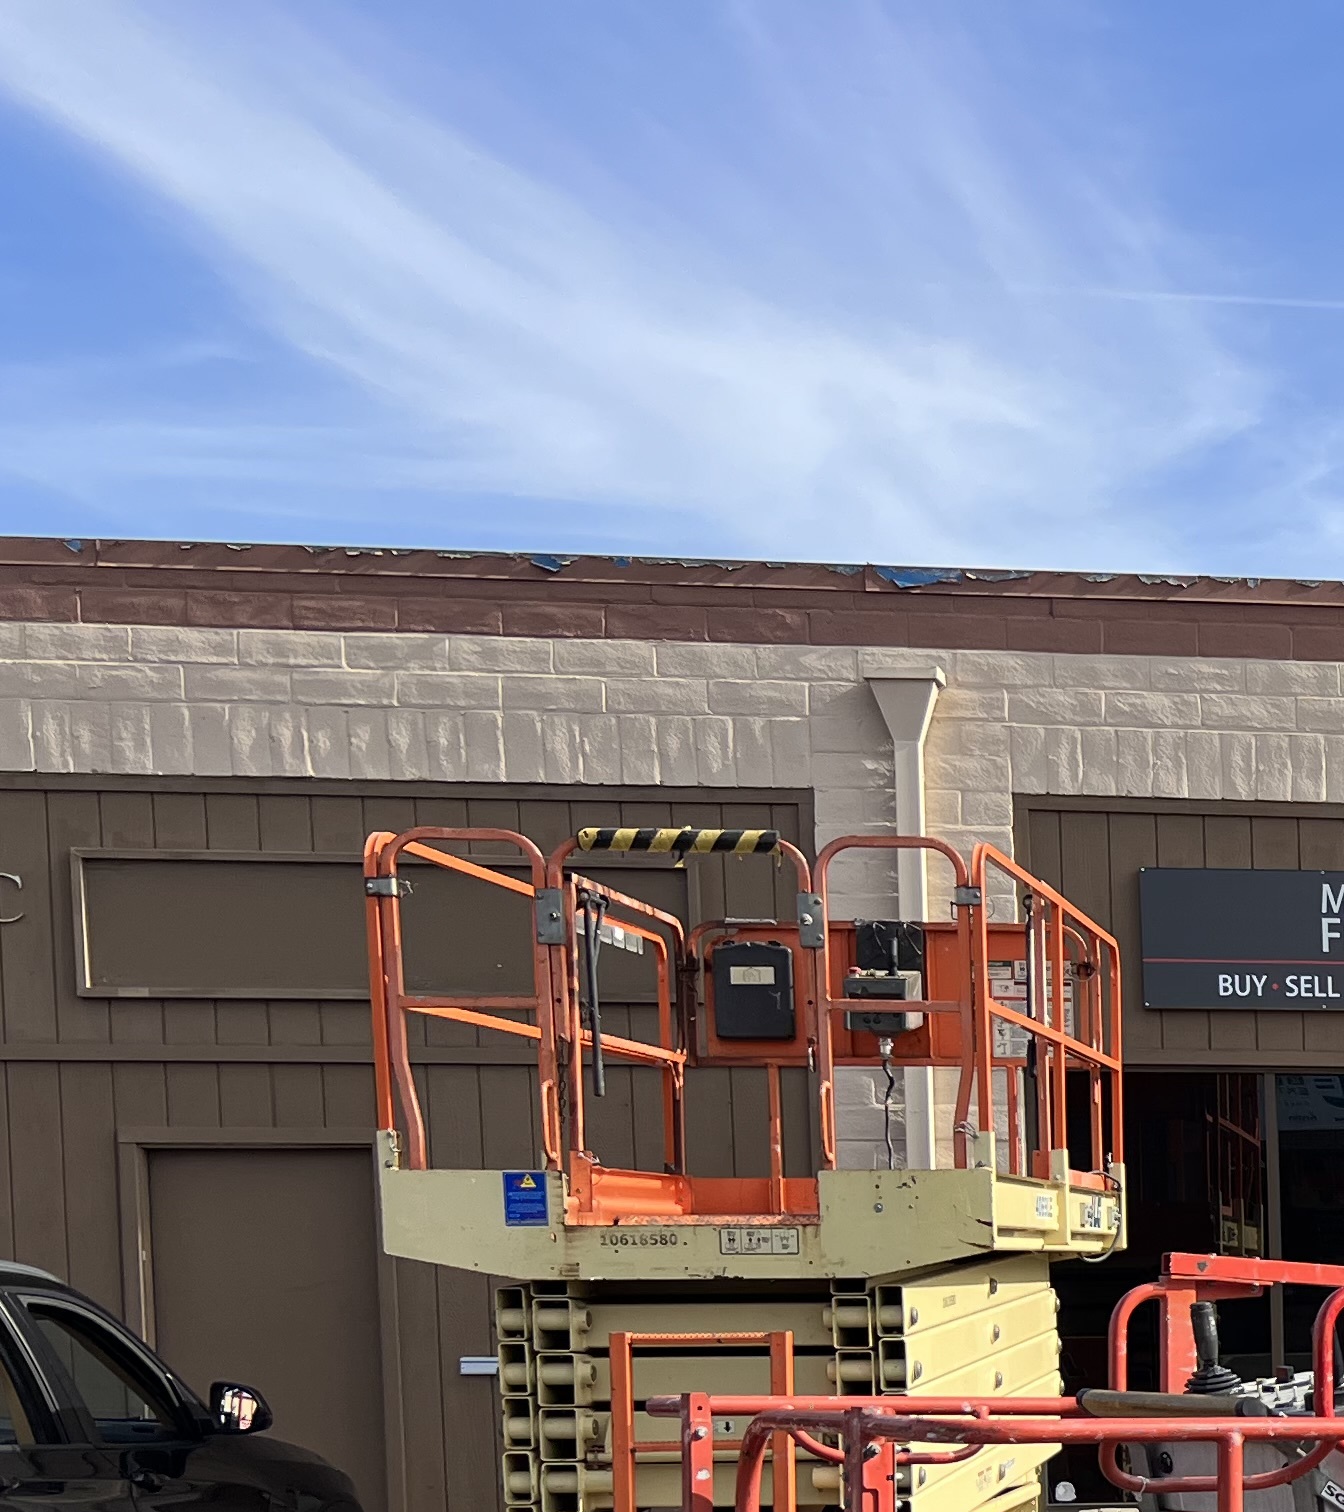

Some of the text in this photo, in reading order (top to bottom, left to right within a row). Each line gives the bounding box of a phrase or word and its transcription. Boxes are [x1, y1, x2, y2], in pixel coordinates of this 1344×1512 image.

[1218, 974, 1268, 997] BUY
[1285, 975, 1341, 998] SELL
[600, 1233, 678, 1246] 10618580
